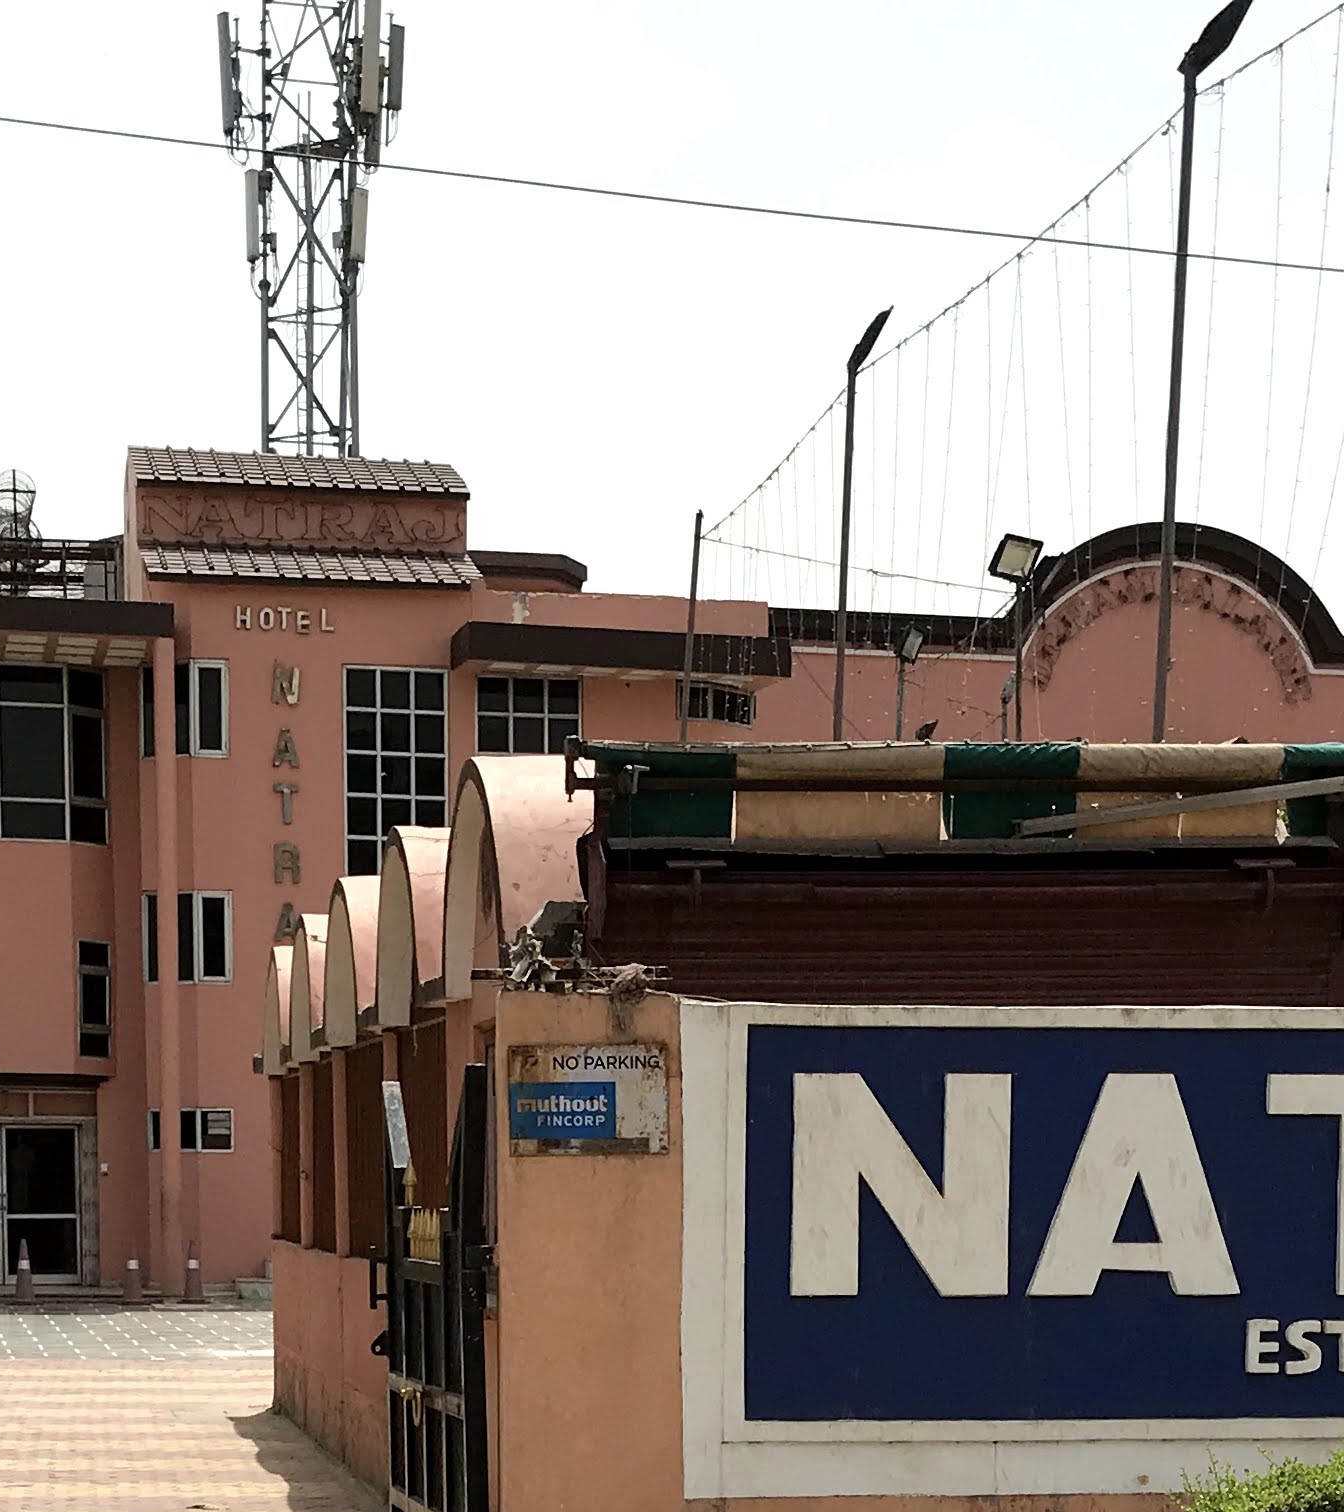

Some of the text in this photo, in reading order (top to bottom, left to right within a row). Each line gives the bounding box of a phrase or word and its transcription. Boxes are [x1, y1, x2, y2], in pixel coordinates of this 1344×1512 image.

[141, 495, 464, 545] NATRAJ
[235, 605, 335, 635] HOTEL
[552, 1055, 661, 1071] NO PARKING
[517, 1094, 608, 1113] muthoot
[537, 1115, 606, 1127] FINCORP
